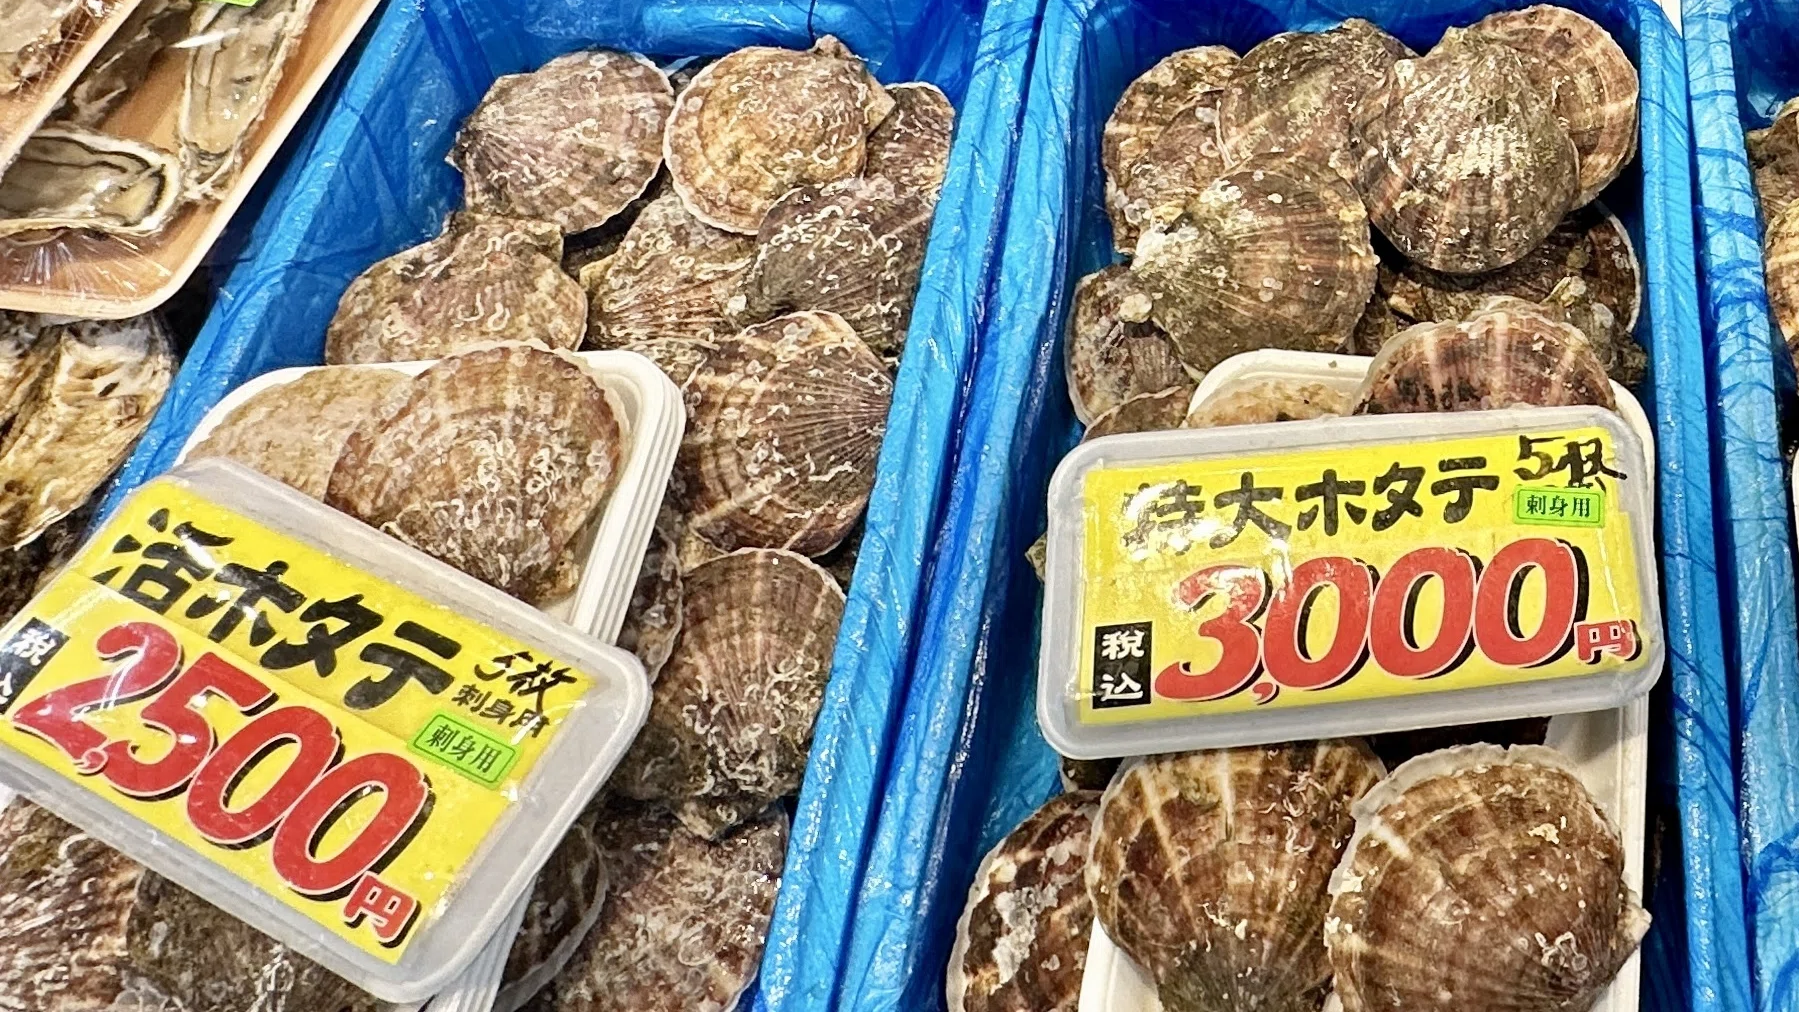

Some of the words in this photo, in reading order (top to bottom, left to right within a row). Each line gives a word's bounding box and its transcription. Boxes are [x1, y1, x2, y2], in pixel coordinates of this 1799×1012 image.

[1123, 456, 1499, 556] 特大ホタテ
[1526, 495, 1591, 518] 刺身用
[92, 507, 462, 710] 活ホタテ
[1100, 628, 1146, 702] 税込
[451, 684, 550, 738] 刺身用
[426, 723, 502, 773] 刺身用
